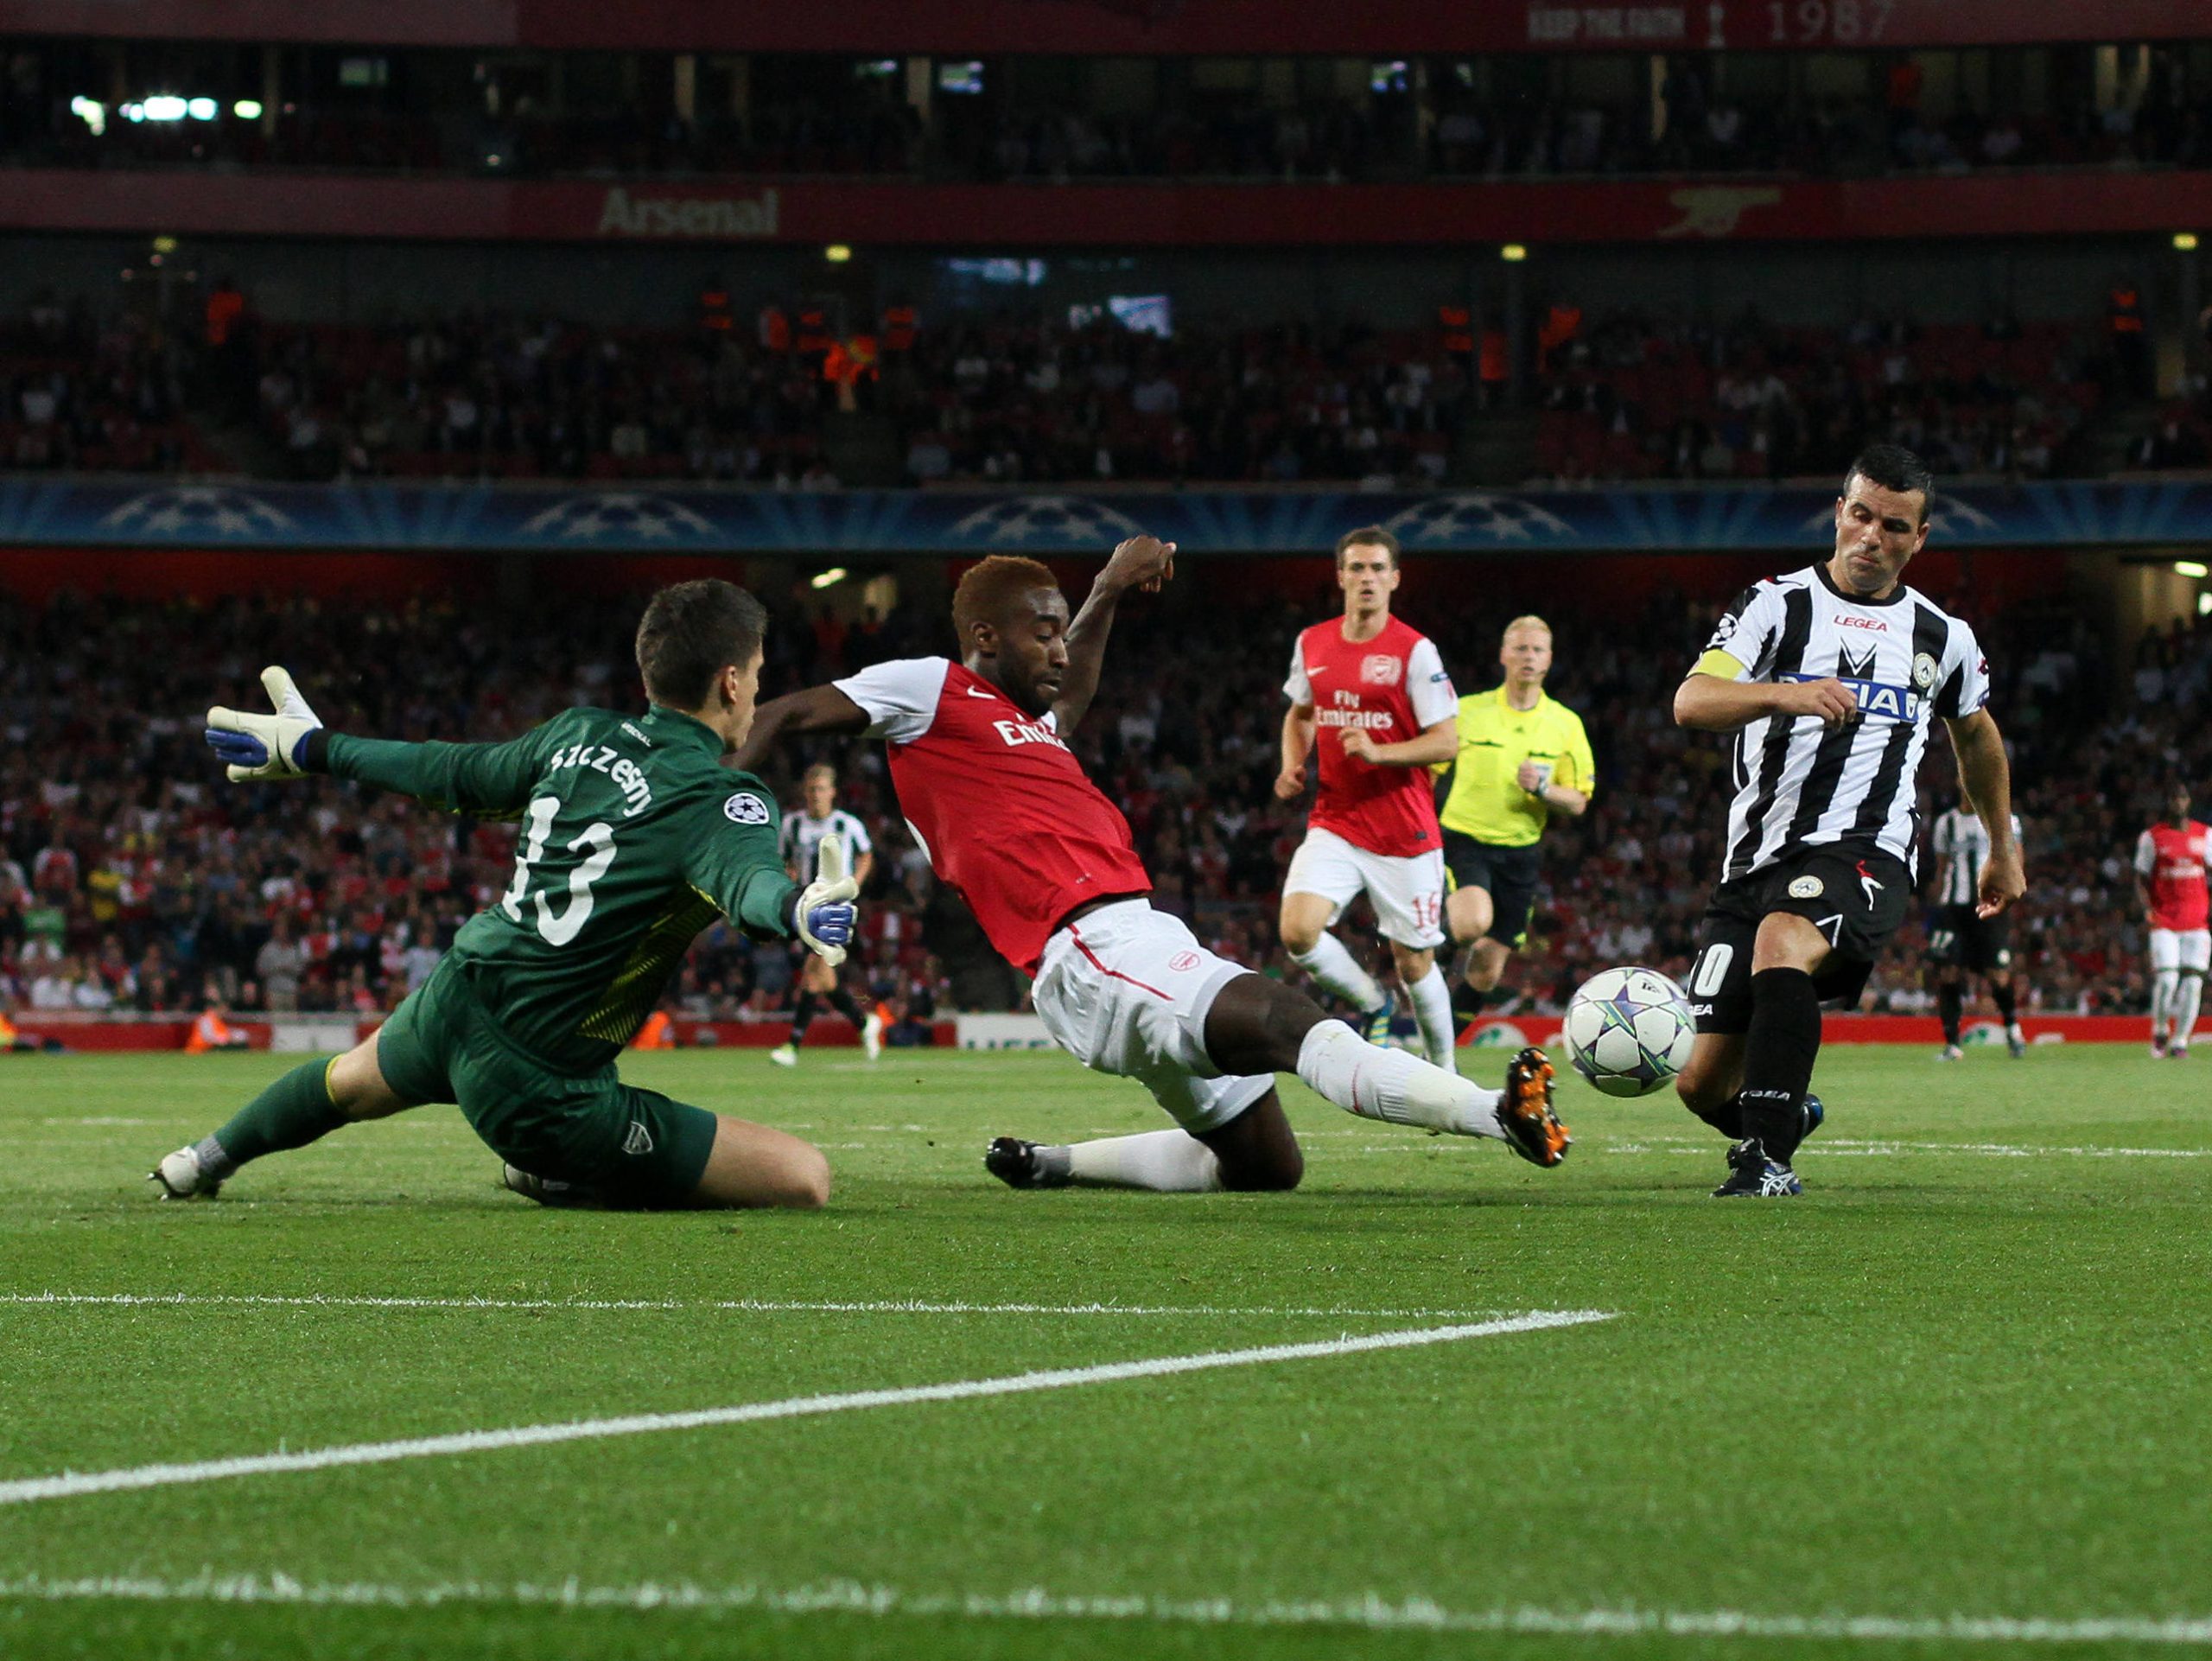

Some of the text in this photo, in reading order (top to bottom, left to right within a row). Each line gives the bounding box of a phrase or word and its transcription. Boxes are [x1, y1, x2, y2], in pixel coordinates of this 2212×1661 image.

[1769, 0, 1893, 42] 1987
[597, 186, 779, 237] Arsenal
[1834, 614, 1888, 633] LEGEA
[1314, 705, 1395, 730] Emirates
[1333, 689, 1361, 709] Fly
[500, 796, 619, 947] 13
[1411, 891, 1441, 931] 16
